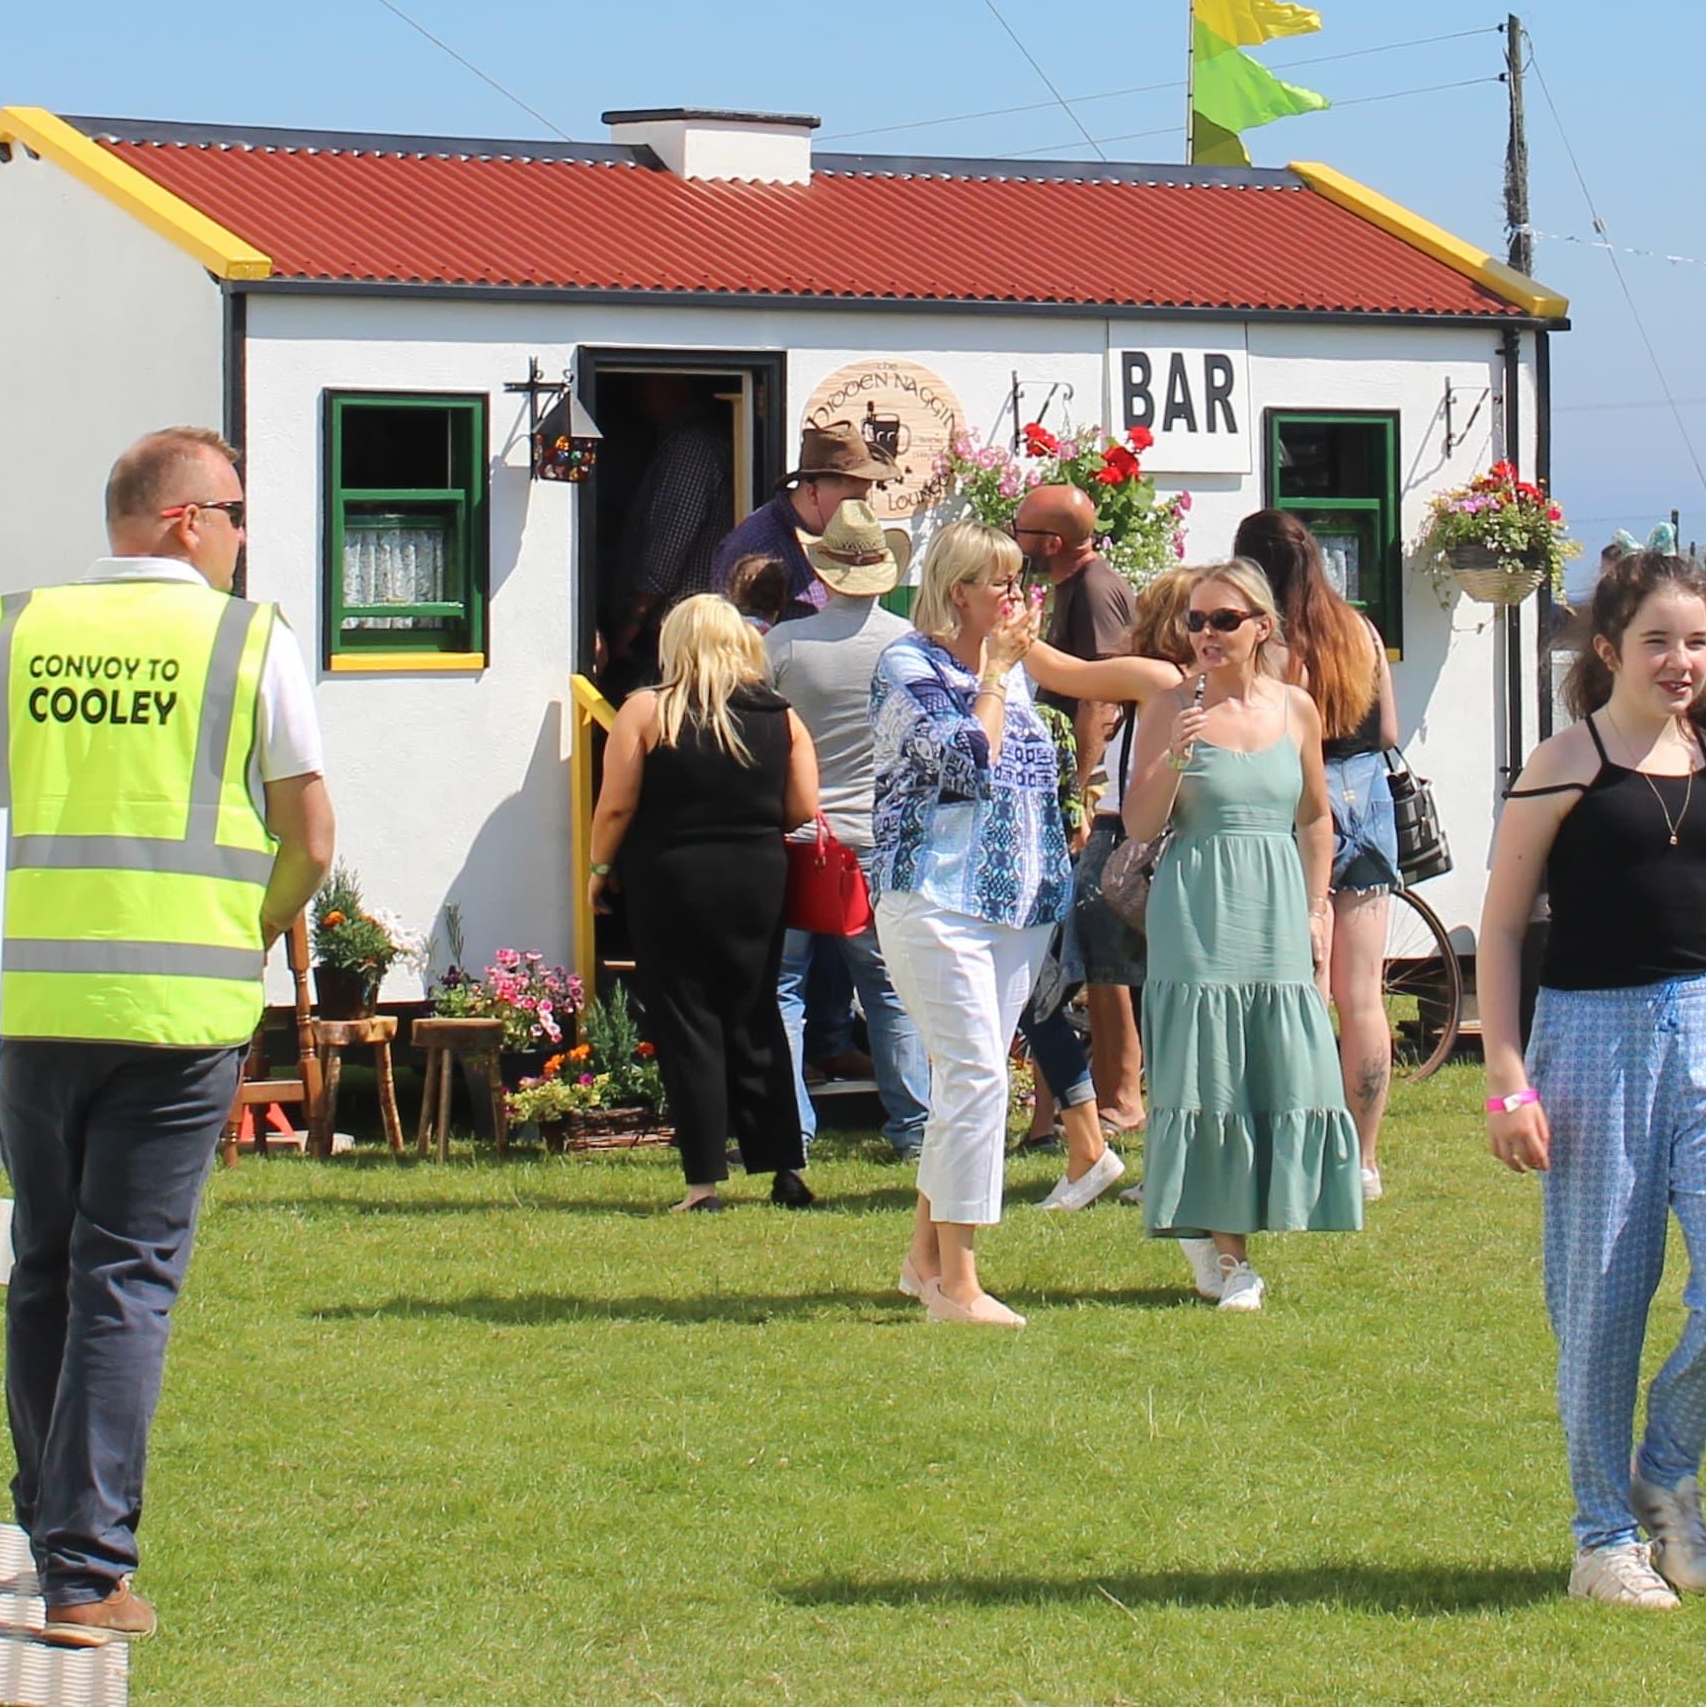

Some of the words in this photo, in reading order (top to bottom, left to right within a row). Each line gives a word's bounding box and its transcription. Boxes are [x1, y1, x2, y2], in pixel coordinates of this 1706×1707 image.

[1121, 350, 1239, 434] BAR
[29, 654, 141, 681] CONVOY
[148, 658, 180, 682] TO
[28, 686, 178, 726] COOLEY
